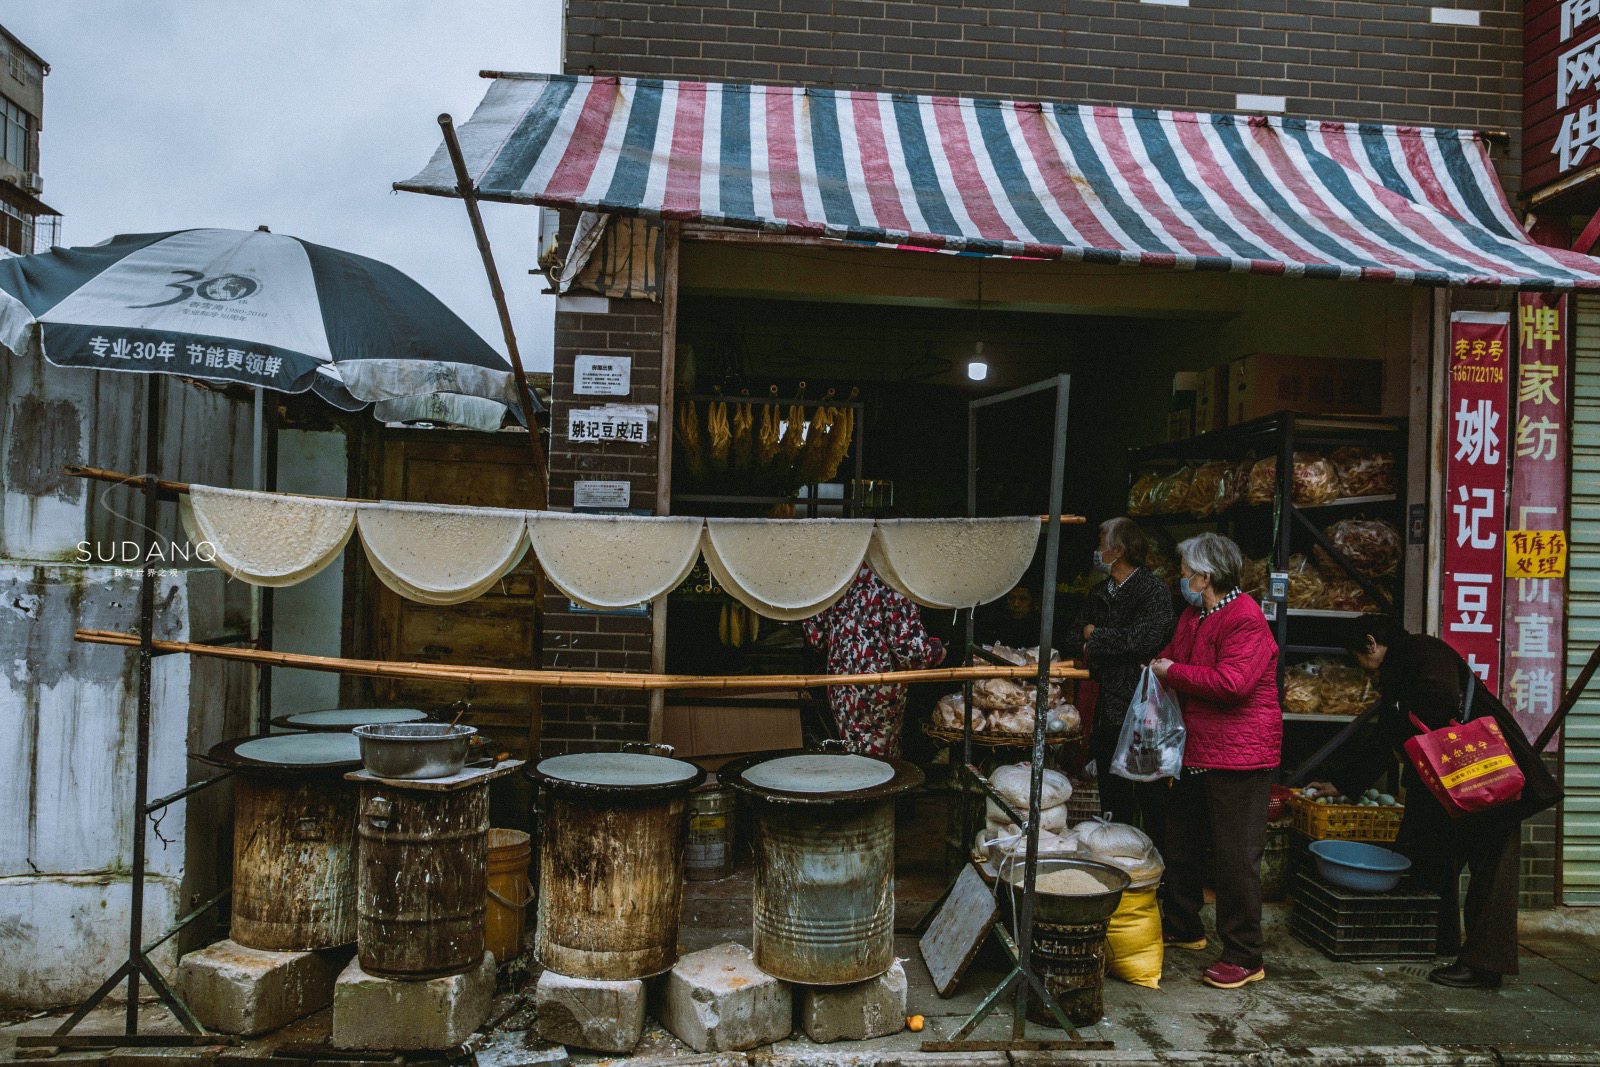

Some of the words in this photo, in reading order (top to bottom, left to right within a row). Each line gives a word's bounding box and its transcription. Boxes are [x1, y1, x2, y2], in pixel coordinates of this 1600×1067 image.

[88, 335, 176, 362] 专业30年
[186, 343, 282, 378] 节能更领鲜
[1455, 338, 1504, 361] 老字号
[1453, 365, 1503, 383] 13677221794
[571, 420, 644, 440] 姚记豆皮店
[1450, 396, 1500, 683] 姚记豆
[1512, 532, 1564, 556] 有库存
[1514, 556, 1562, 574] 处理
